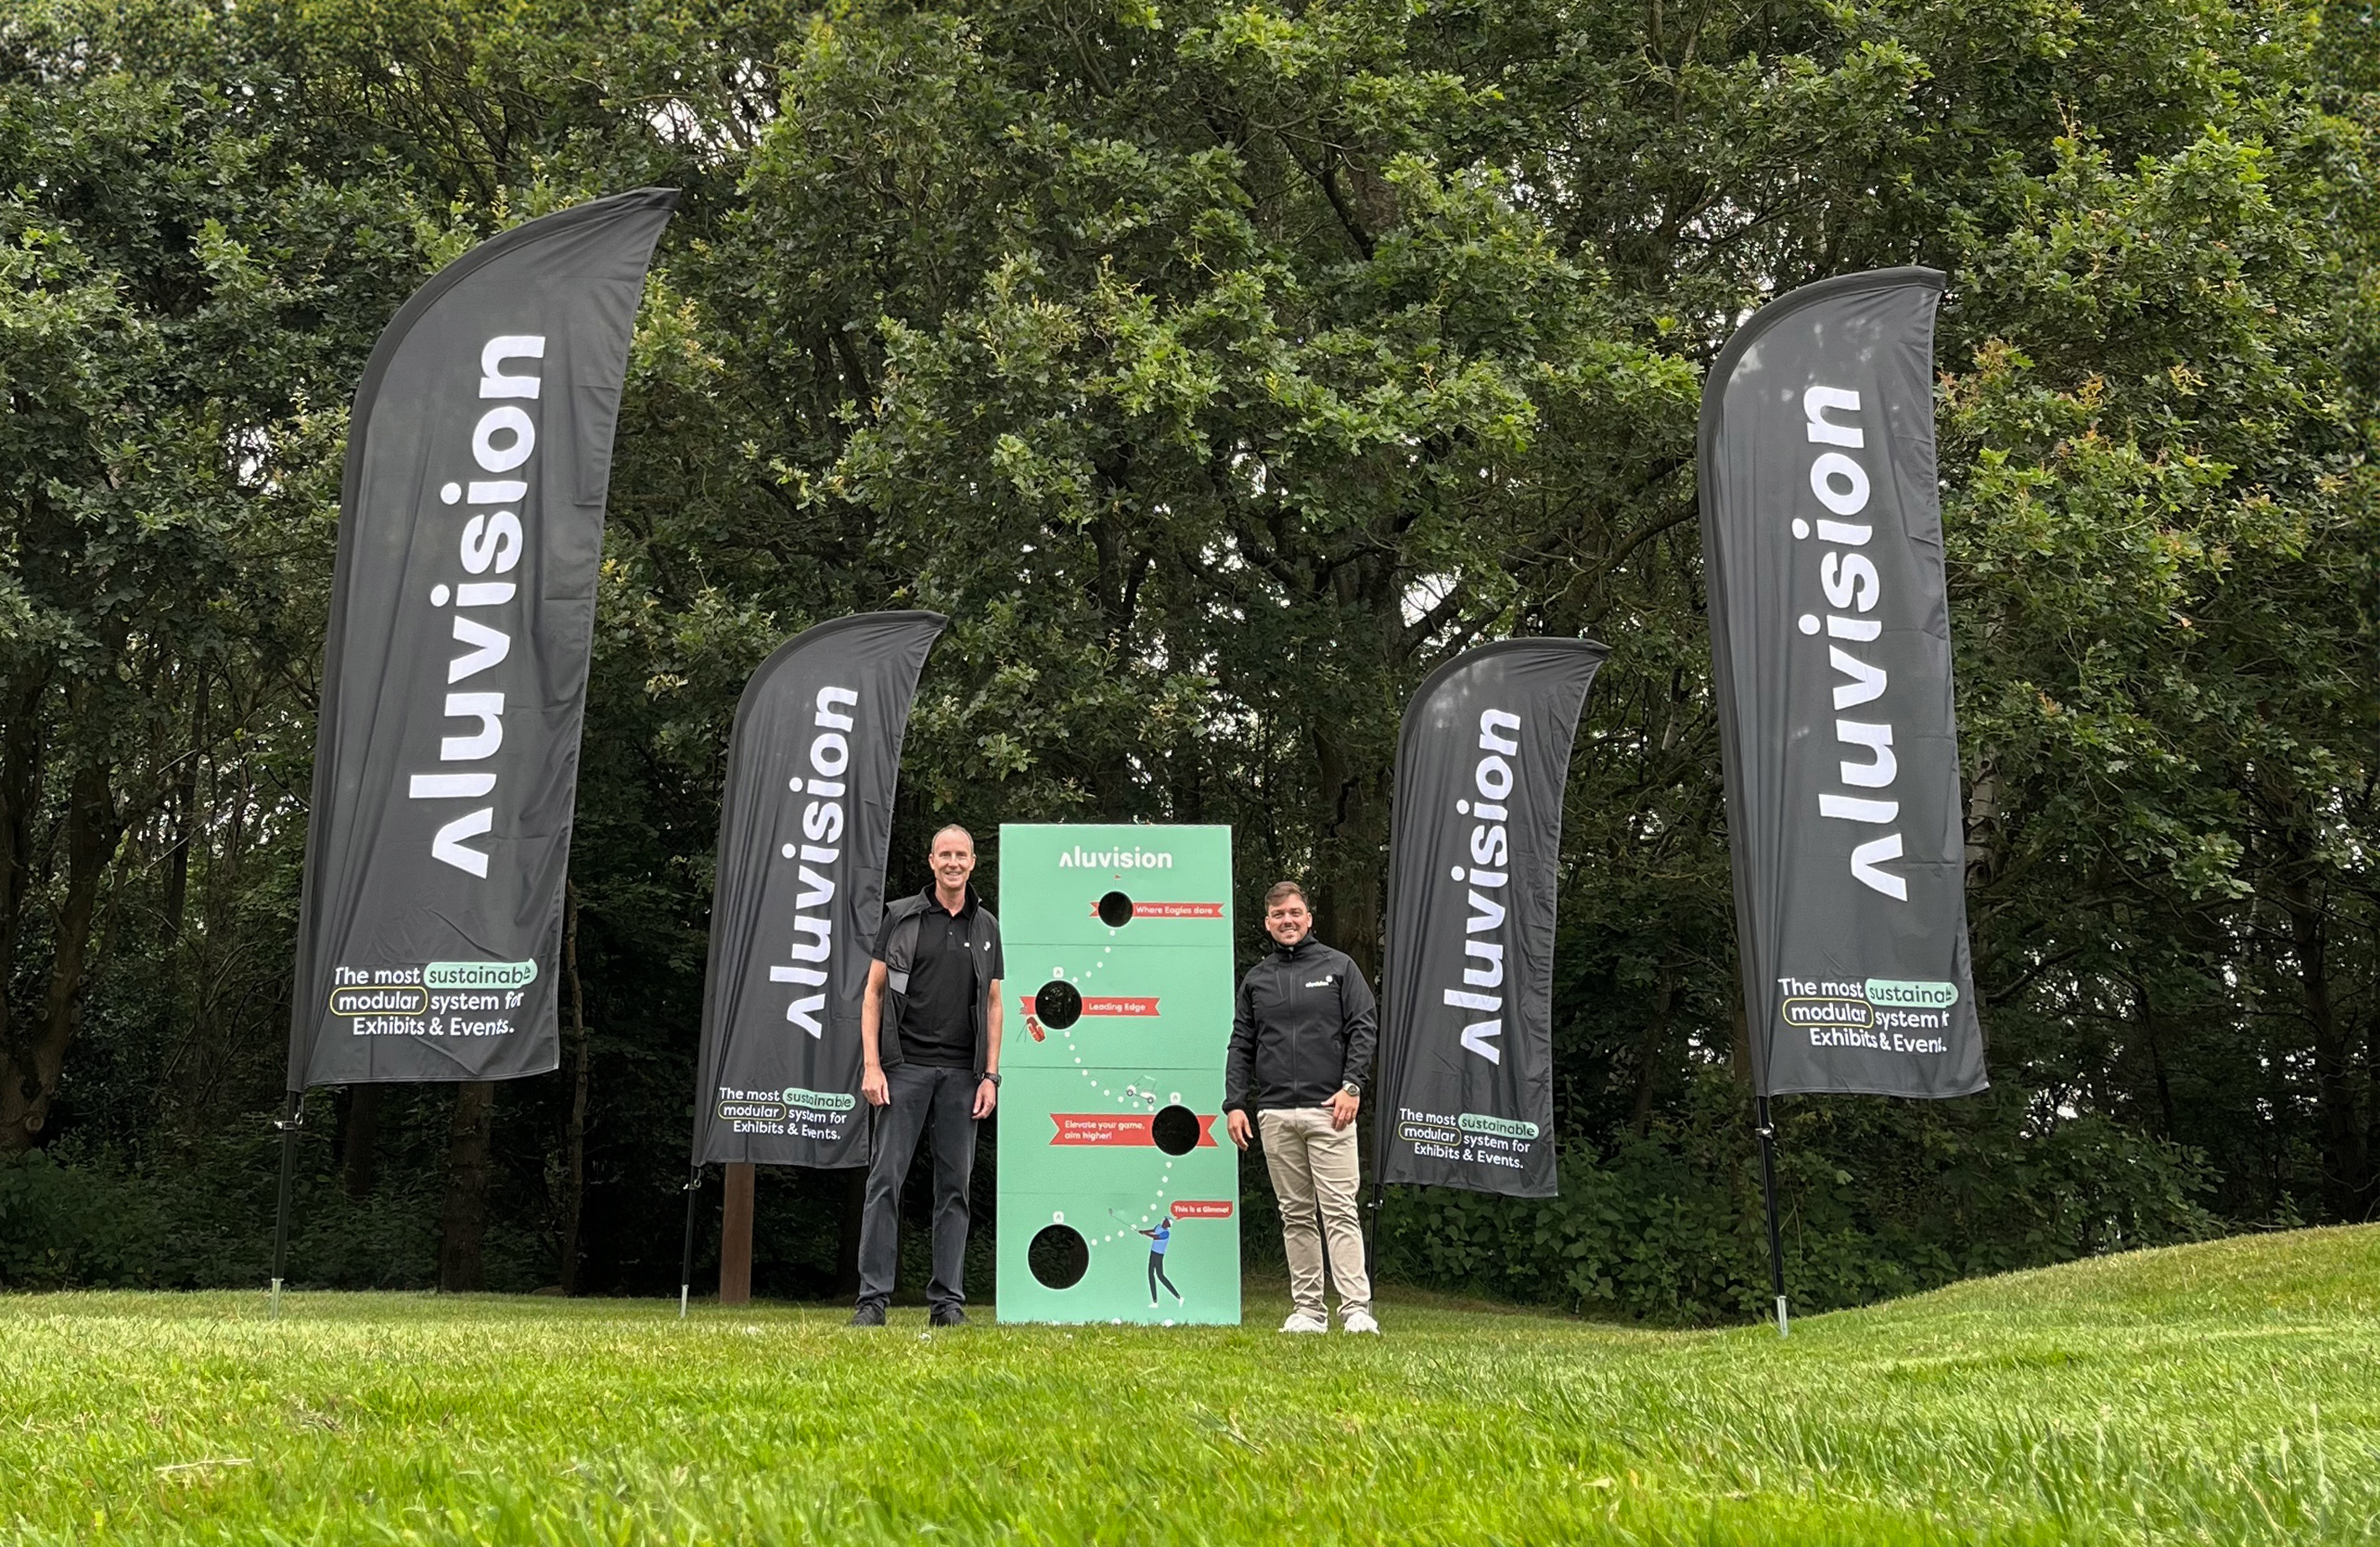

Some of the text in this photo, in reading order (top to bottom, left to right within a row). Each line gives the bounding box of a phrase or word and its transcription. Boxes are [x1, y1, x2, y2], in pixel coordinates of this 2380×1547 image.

[409, 335, 546, 879] Aluvision
[1791, 385, 1908, 902] Aluvision
[770, 685, 859, 1039] Aluvision
[1059, 845, 1173, 869] Aluvision
[1443, 708, 1521, 1066] Aluvision
[1136, 906, 1213, 916] Where Eagles dare
[334, 966, 368, 986] The
[374, 967, 421, 985] most
[1778, 977, 1817, 997] The
[1821, 981, 1864, 998] most
[339, 991, 420, 1011] modular
[430, 992, 500, 1014] system
[1089, 1002, 1146, 1013] Leading Edge
[353, 1016, 515, 1036] Exhibits & Events.
[1791, 1002, 1867, 1023] modular
[1875, 1010, 1939, 1031] system
[1810, 1027, 1878, 1049] Exhibits
[1879, 1032, 1892, 1051] &
[719, 1087, 852, 1108] The most sustainable
[723, 1105, 848, 1124] modular system for
[1064, 1120, 1096, 1129] Elevate
[1098, 1122, 1116, 1131] your
[1399, 1108, 1536, 1137] The most sustainable
[733, 1120, 784, 1134] Exhibits
[787, 1123, 798, 1136] &
[1064, 1131, 1112, 1141] aim higher!
[1404, 1126, 1531, 1154] modular system for
[1414, 1142, 1524, 1169] Exhibits & Events.
